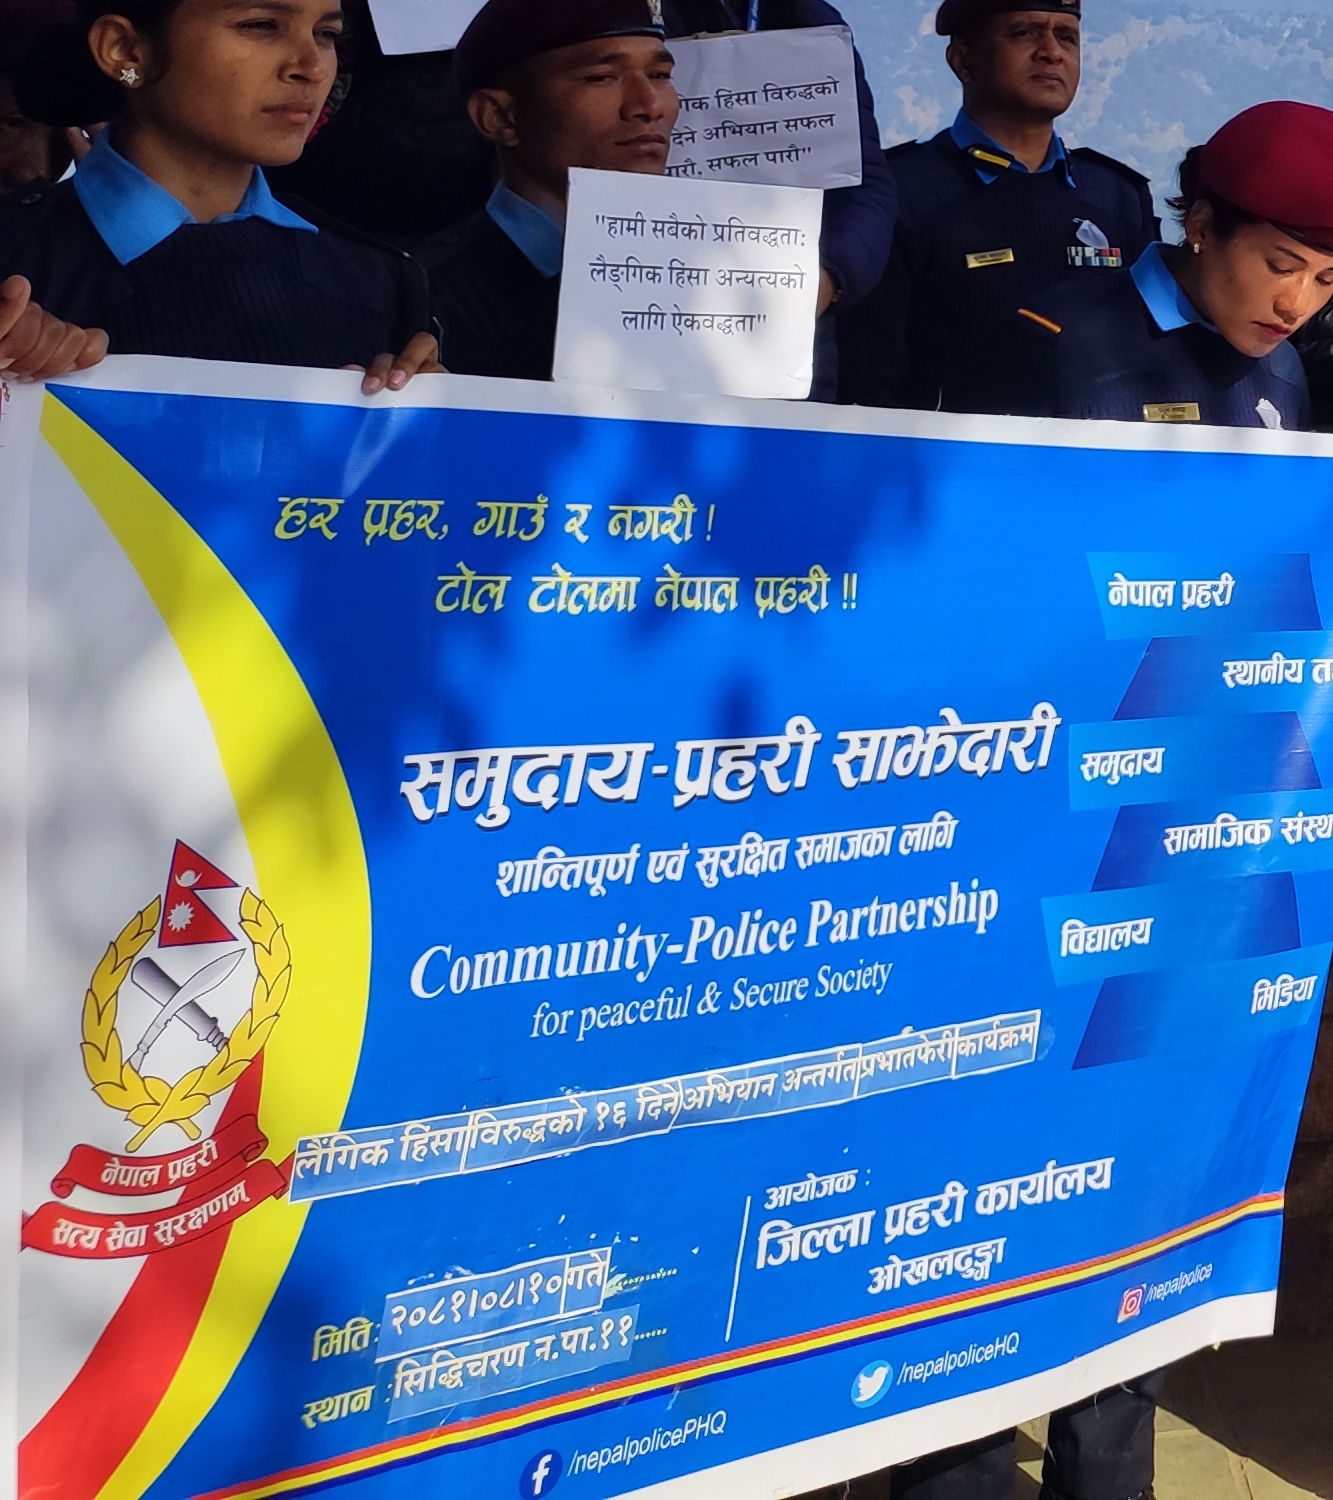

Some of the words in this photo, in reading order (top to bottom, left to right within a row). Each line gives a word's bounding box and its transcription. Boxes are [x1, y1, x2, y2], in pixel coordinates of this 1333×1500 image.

[763, 76, 840, 103] विरुद्धको
[703, 120, 779, 140] अभियान
[783, 113, 836, 133] सफल
[707, 153, 759, 171] सफल
[651, 212, 707, 241] सबैको
[715, 263, 808, 289] अन्यत्यको
[621, 303, 667, 331] लागि
[275, 496, 344, 541] हर
[363, 499, 449, 545] प्रहर,
[474, 494, 548, 542] गाउँ
[564, 502, 592, 543] र
[607, 494, 697, 543] नगरी
[435, 562, 511, 614] टोल
[528, 563, 641, 614] टोलमा
[654, 563, 740, 614] नेपाल
[754, 564, 831, 619] प्रहरी
[1107, 572, 1175, 608] नेपाल
[1179, 572, 1235, 611] प्रहरी
[1222, 652, 1305, 688] स्थानीय
[400, 715, 821, 829] समुदाय-प्रहरी
[832, 701, 1061, 790] साझेदारी
[1080, 747, 1165, 786] समुदाय
[497, 842, 642, 899] शान्तिपूर्ण
[646, 841, 683, 886] एवं
[696, 834, 788, 889] सुरक्षित
[795, 824, 892, 872] समाजका
[898, 810, 960, 858] लागि
[1162, 809, 1272, 856] सामाजिक
[410, 911, 797, 1000] Community-Police
[804, 880, 999, 950] Partnership
[1061, 915, 1153, 959] विद्यालय
[530, 1004, 569, 1040] for
[575, 983, 692, 1041] peaceful
[696, 983, 723, 1013] &
[729, 974, 810, 1014] Secure
[813, 958, 894, 1003] Society
[1250, 973, 1318, 1016] मिडिया
[295, 1135, 394, 1178] लैंगिक
[468, 1098, 587, 1150] विरुद्धको
[636, 1080, 680, 1122] दिने
[682, 1072, 778, 1111] अभियान
[783, 1051, 858, 1093] अन्तर्गत
[956, 1020, 1036, 1058] कार्यक्रम
[101, 1157, 163, 1188] नेपाल
[167, 1138, 217, 1185] प्रहरी
[764, 1168, 859, 1211] आयोजक
[53, 1218, 104, 1249] सत्य
[105, 1221, 149, 1252] सेवा
[755, 1215, 871, 1271] जिल्ला
[884, 1180, 966, 1246] प्रहरी
[975, 1155, 1116, 1214] कार्यालय
[1144, 1261, 1213, 1306] /nepalpolice
[393, 1341, 529, 1399] सिद्धिचरण
[895, 1329, 1021, 1386] /nepalpoliceHQ
[567, 1410, 728, 1478] /nepalpolicePHQ
